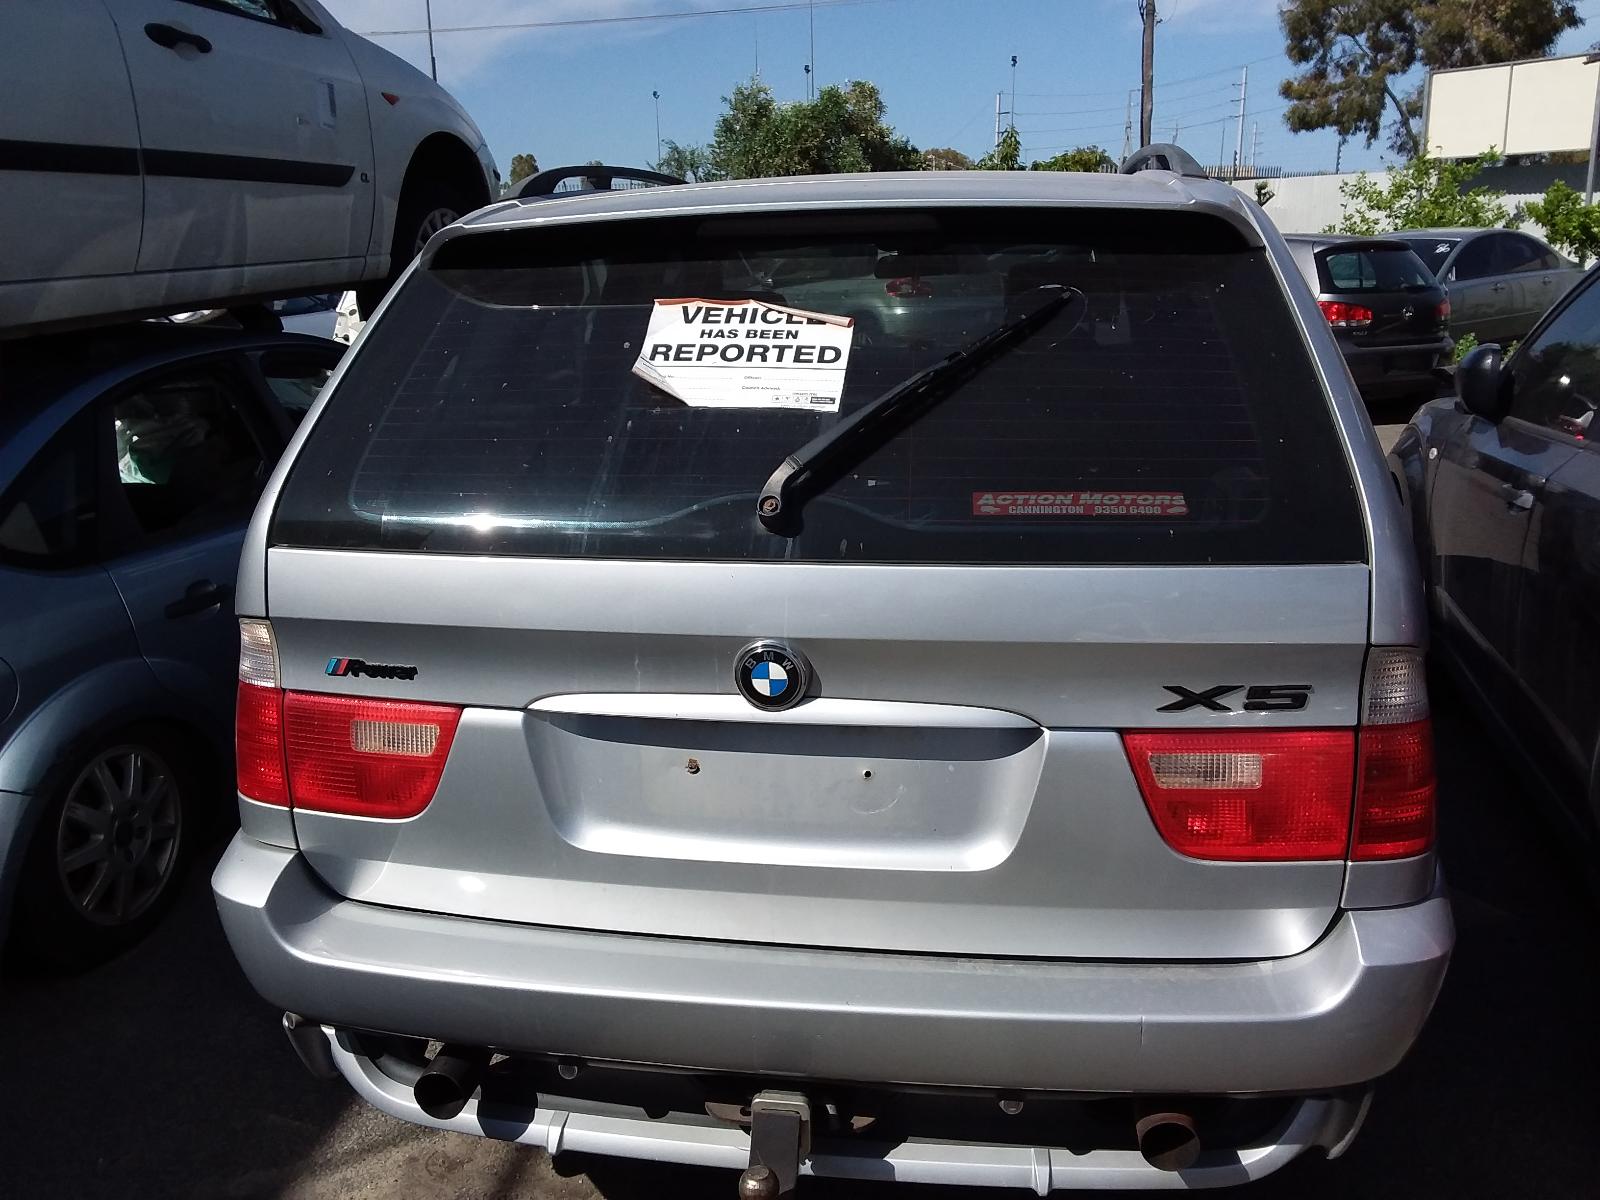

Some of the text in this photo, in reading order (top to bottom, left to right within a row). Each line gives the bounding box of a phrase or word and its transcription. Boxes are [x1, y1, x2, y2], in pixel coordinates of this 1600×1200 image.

[700, 328, 799, 340] HAS BEEN
[649, 343, 842, 364] REPORTED
[977, 493, 1186, 505] ACTION MOTORS
[1008, 505, 1161, 514] CANNINGTON 9350 6400
[744, 651, 794, 671] BMW
[1156, 684, 1314, 712] X5
